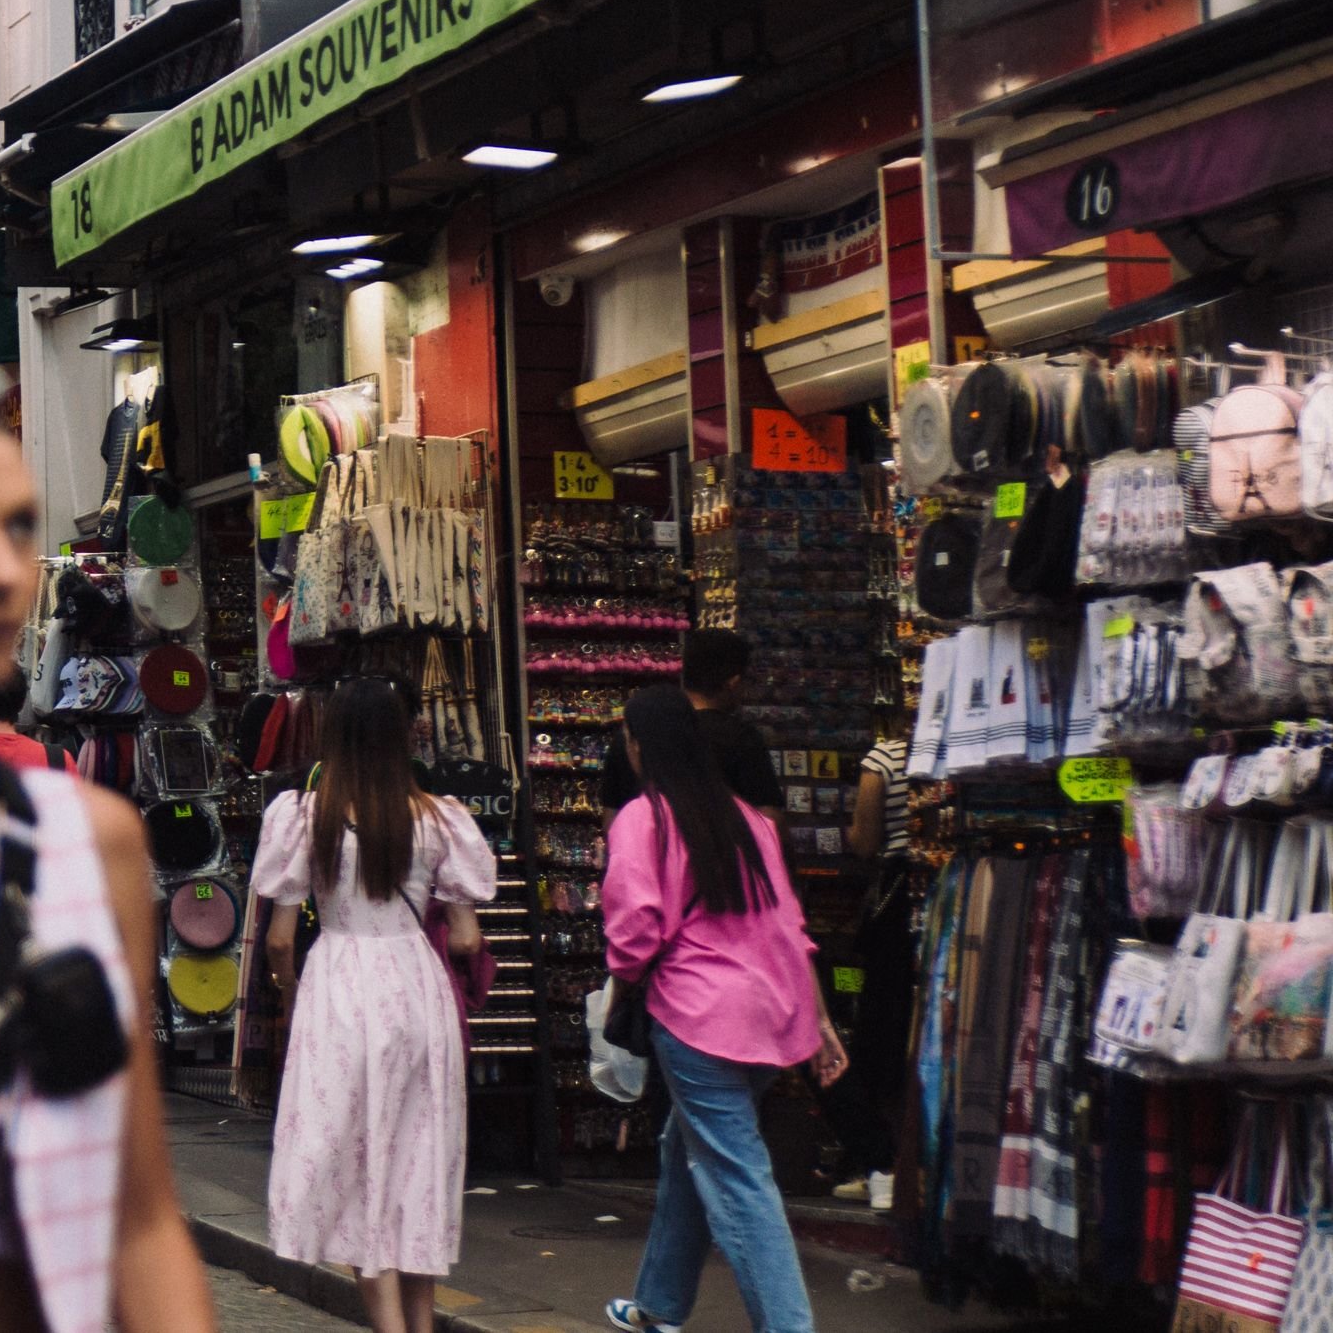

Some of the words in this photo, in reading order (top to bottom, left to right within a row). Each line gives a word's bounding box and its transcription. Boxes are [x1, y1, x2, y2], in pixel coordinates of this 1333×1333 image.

[190, 115, 204, 175] B
[211, 60, 293, 163] ADAM
[71, 180, 93, 240] 18
[1081, 167, 1112, 221] 16
